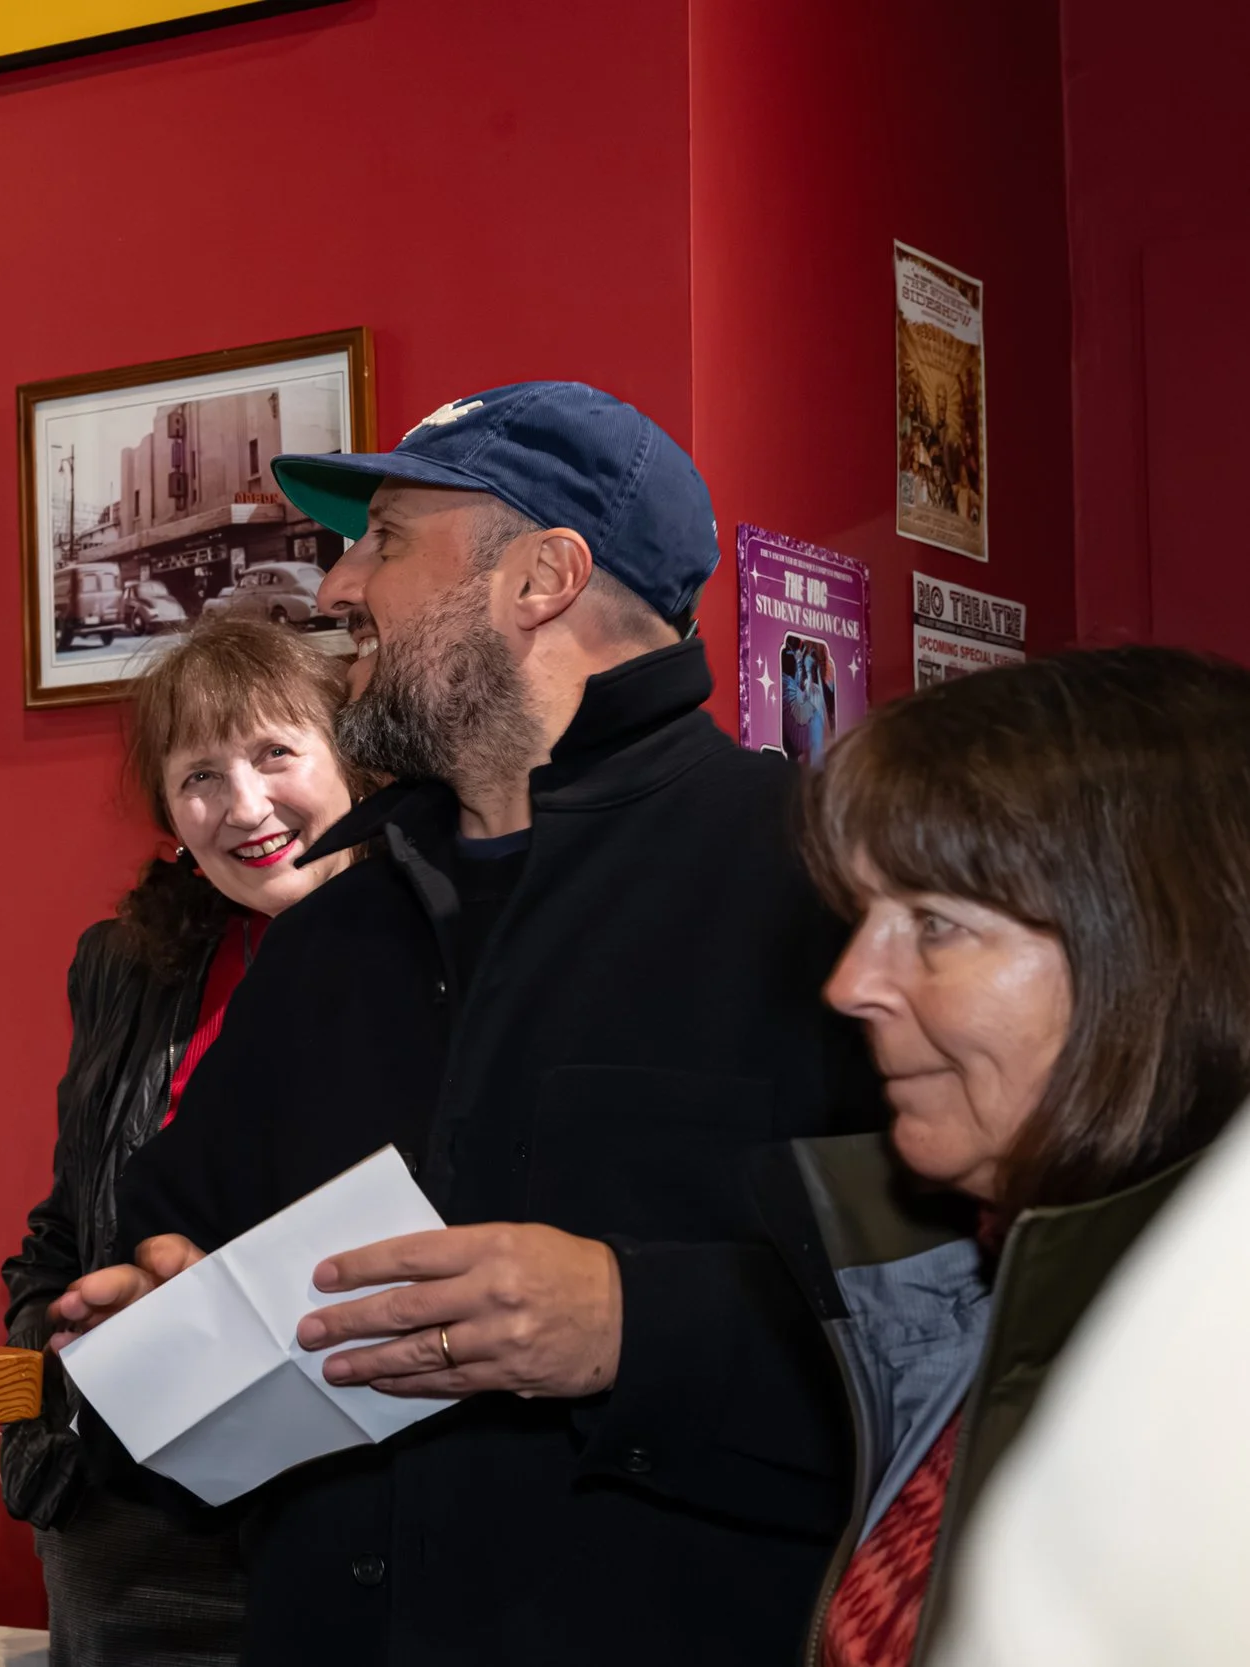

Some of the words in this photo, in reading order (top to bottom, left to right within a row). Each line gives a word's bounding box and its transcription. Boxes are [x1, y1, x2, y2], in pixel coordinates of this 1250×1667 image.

[784, 570, 804, 602] THE
[755, 593, 801, 625] STUDENT
[802, 607, 860, 640] SHOWCASE
[917, 580, 944, 618] RIO
[950, 590, 1022, 638] THEATRE
[918, 635, 958, 658] UPCOMING
[960, 646, 992, 664] SPECIAL
